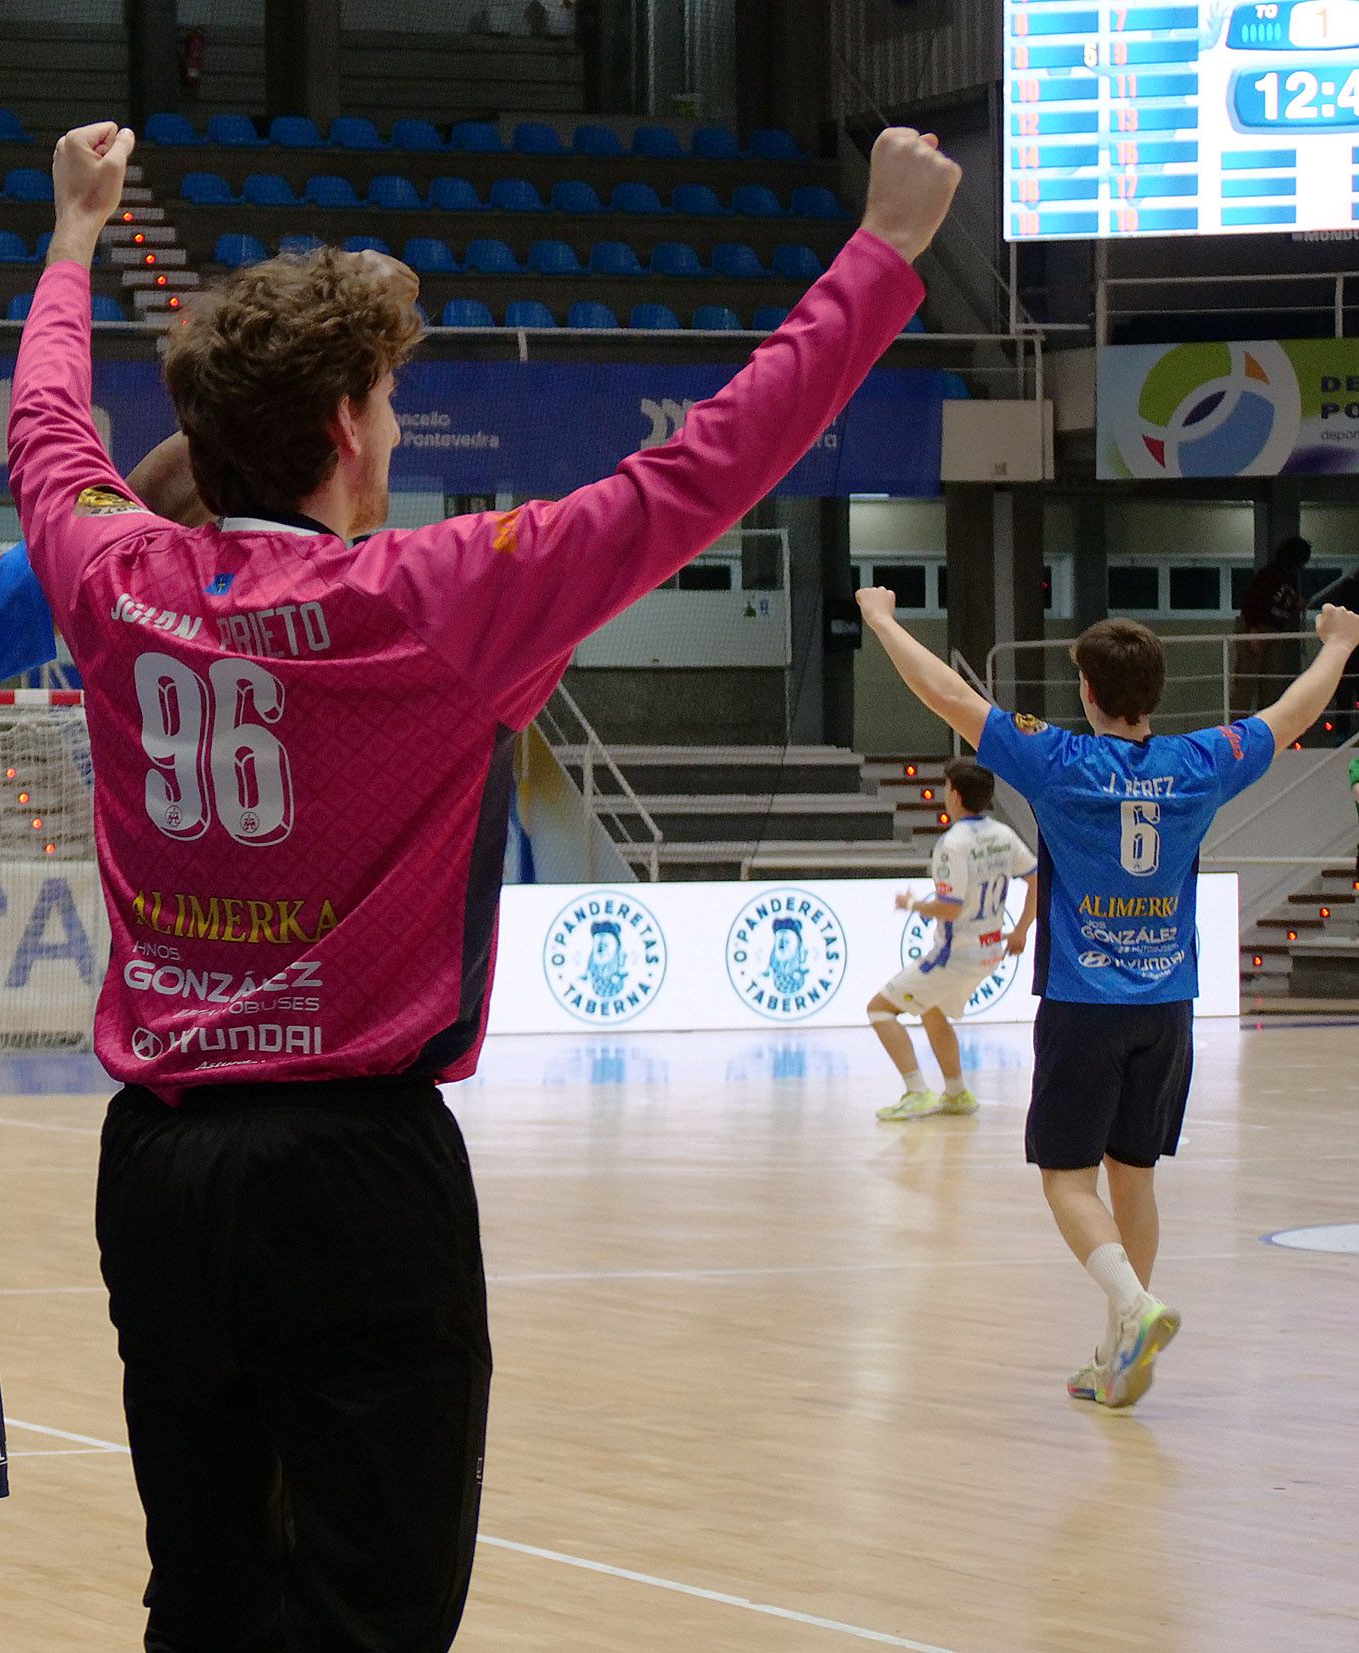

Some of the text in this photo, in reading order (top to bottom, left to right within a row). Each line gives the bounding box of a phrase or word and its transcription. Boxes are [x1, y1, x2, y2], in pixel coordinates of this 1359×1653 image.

[1255, 4, 1279, 19] TO
[215, 601, 332, 657] PRIETO
[134, 652, 294, 847] 96
[1102, 772, 1177, 798] J. PÉREZ
[1120, 800, 1161, 877] 6
[132, 890, 340, 945] ALIMERKA
[1081, 926, 1178, 946] GONZÁLEZ
[563, 981, 652, 1016] TABERNA
[745, 978, 833, 1012] TABERNA
